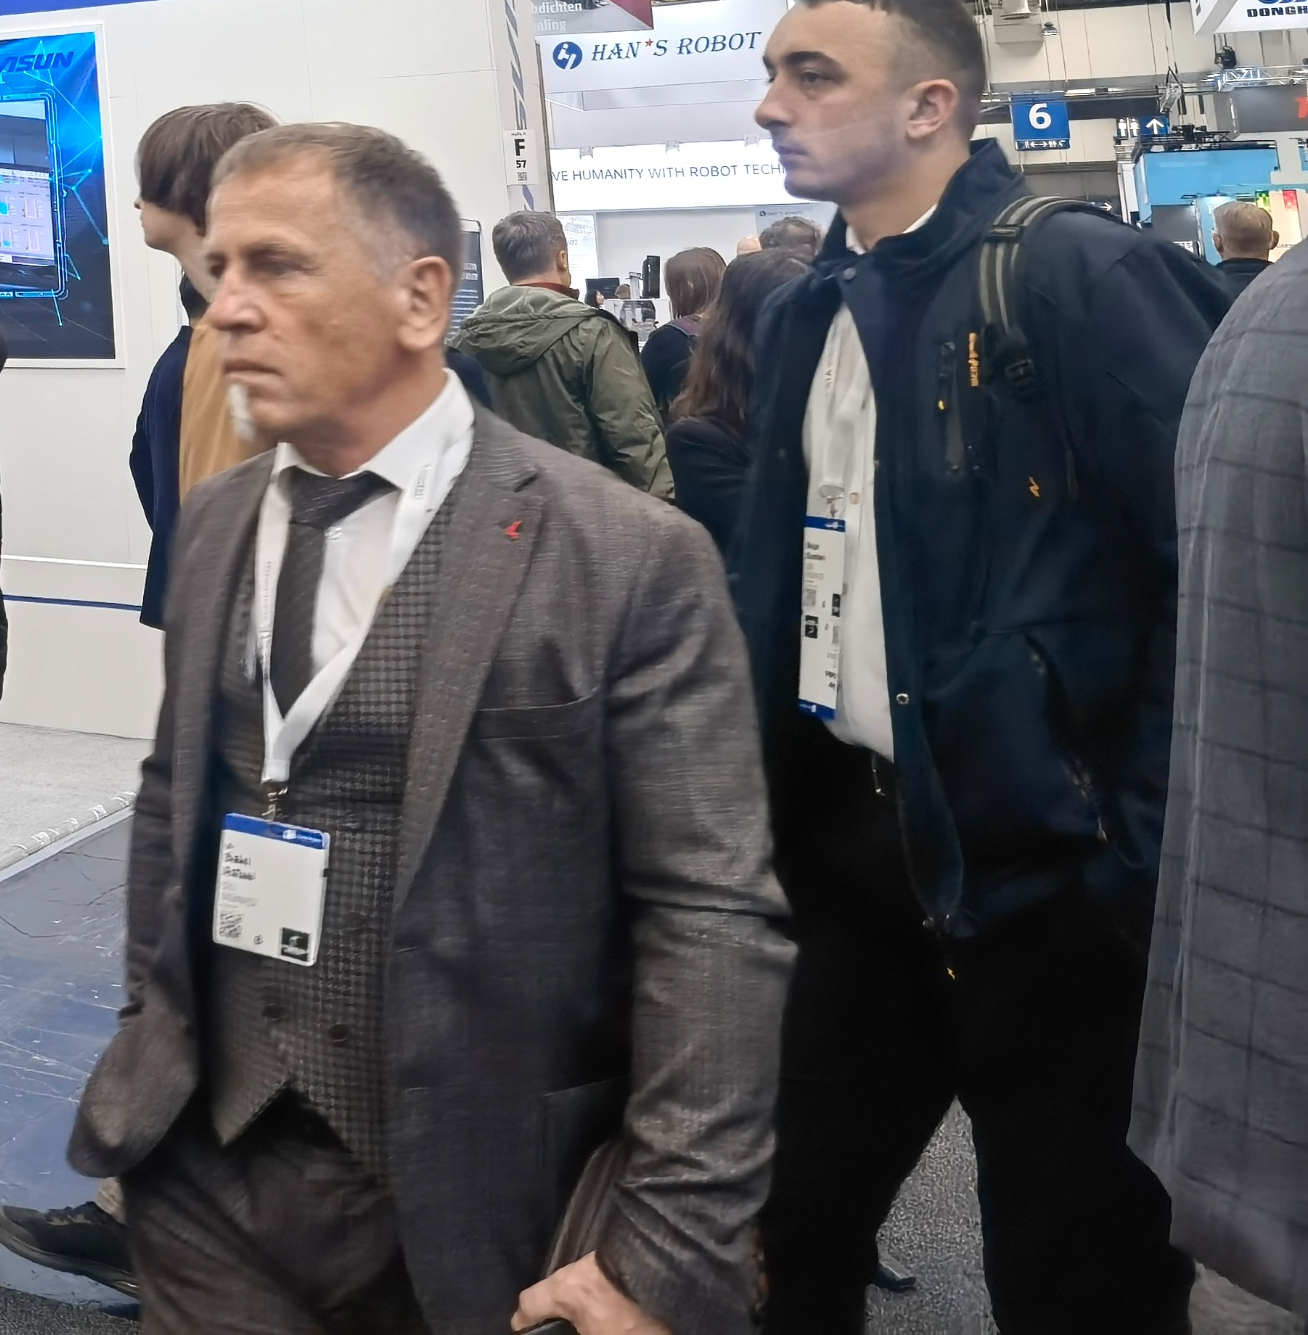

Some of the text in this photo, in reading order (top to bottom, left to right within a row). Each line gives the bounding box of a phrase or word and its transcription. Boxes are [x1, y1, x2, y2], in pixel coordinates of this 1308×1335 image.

[676, 31, 762, 56] ROBOT
[1028, 102, 1052, 131] 6
[514, 138, 526, 156] F
[515, 159, 527, 169] 57
[572, 168, 644, 181] HUMANITY
[647, 167, 685, 179] WITH
[690, 165, 738, 177] ROBOT
